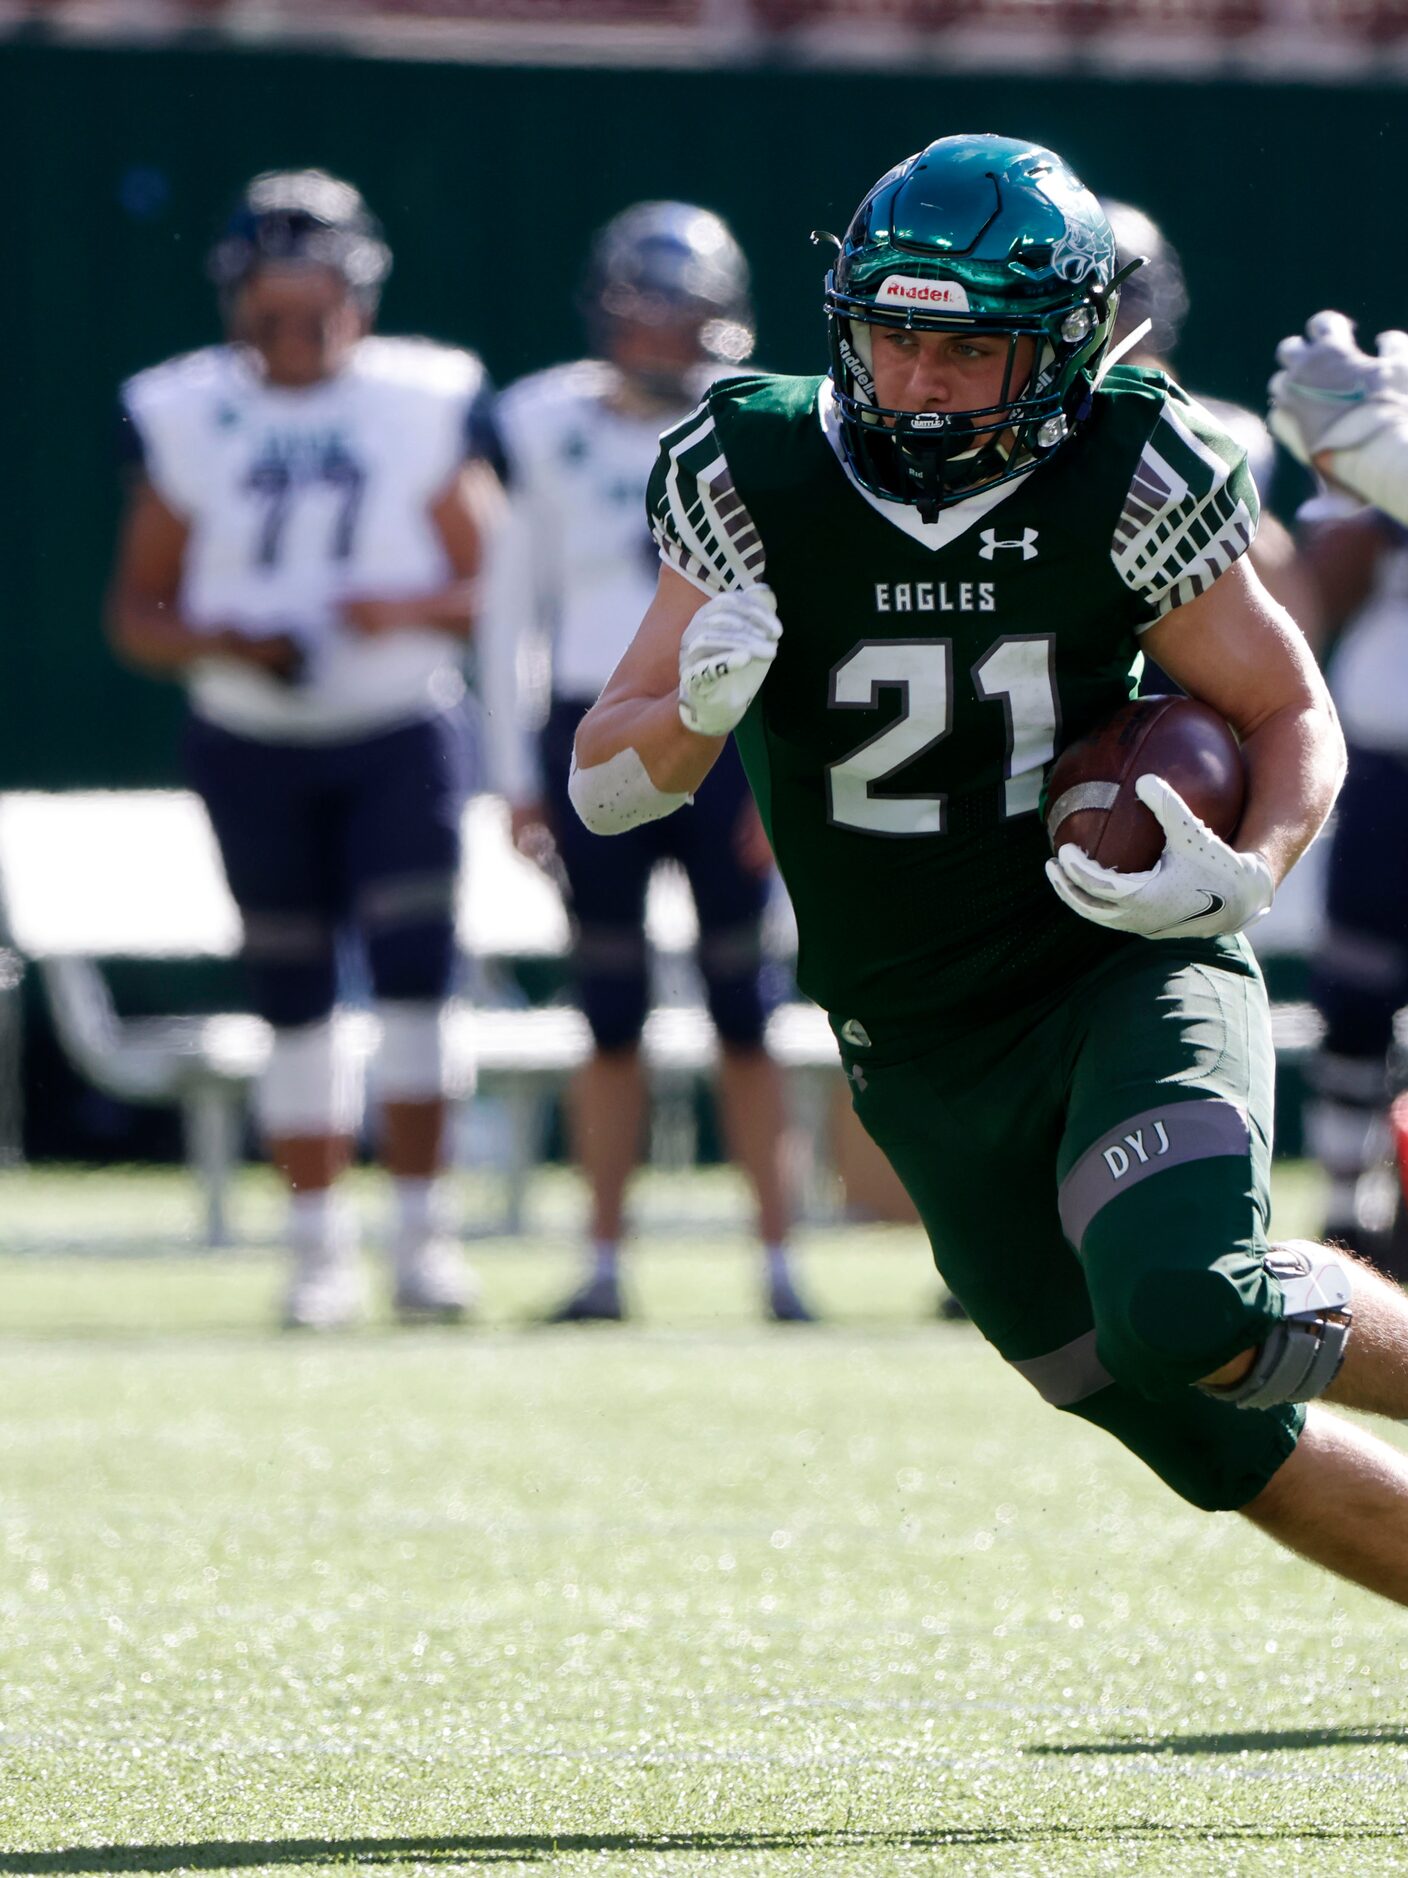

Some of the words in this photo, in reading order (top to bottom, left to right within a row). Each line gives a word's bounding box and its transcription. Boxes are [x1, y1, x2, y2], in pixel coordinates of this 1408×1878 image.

[840, 338, 875, 395] Riddell
[875, 582, 996, 612] EAGLES
[825, 632, 1062, 838] 21
[1102, 1120, 1170, 1180] DYJ
